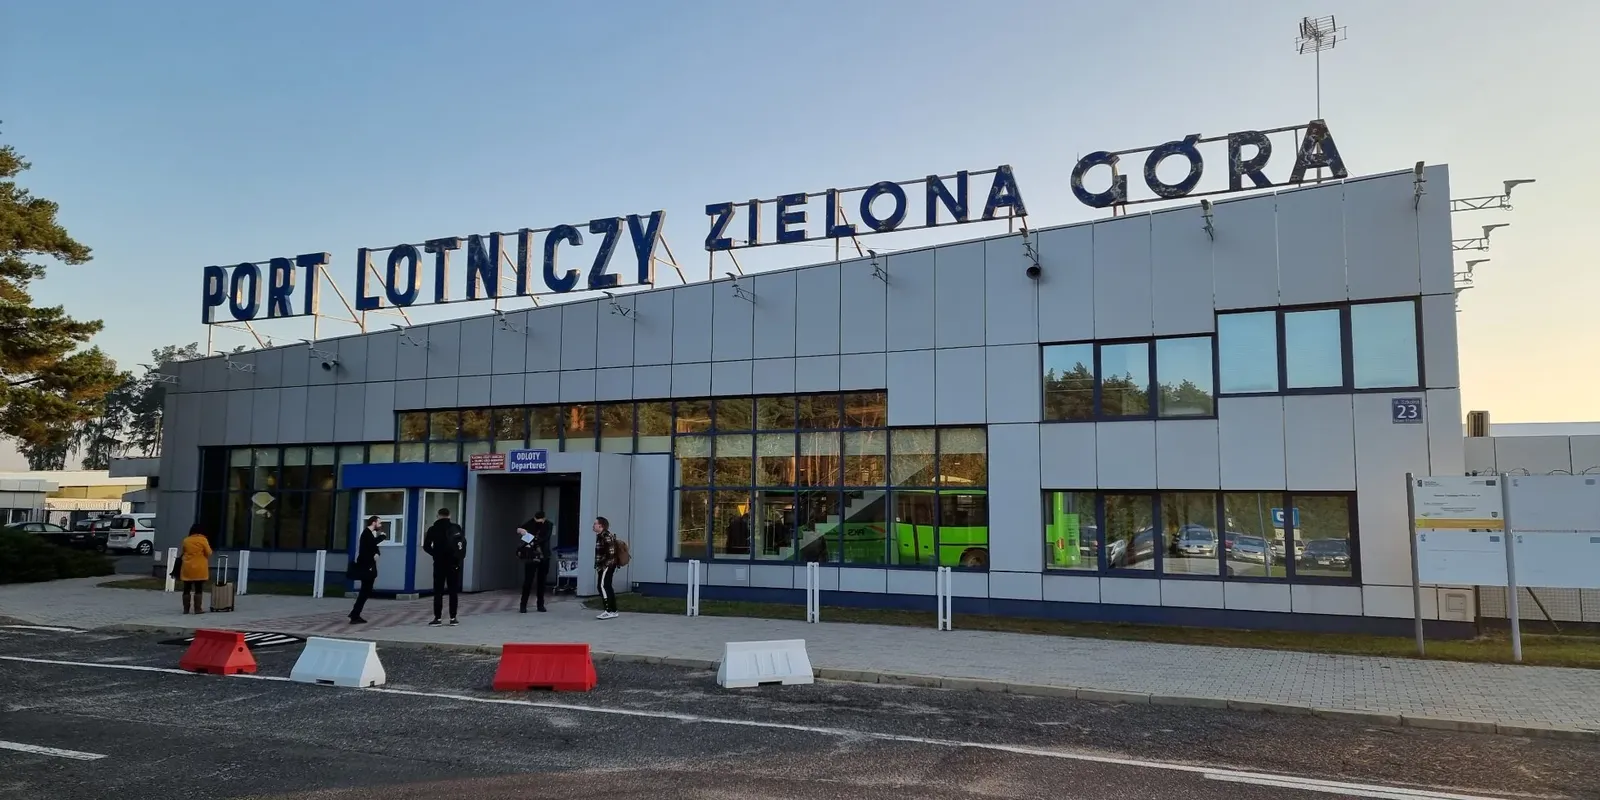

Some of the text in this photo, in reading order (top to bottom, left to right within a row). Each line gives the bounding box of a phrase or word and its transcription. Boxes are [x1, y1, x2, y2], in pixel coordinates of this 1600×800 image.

[202, 119, 1348, 324] PORT LOTNICZY ZIELONA GÓRA
[1397, 405, 1417, 418] 23
[516, 452, 540, 460] ODLOTY
[511, 462, 546, 471] Departures
